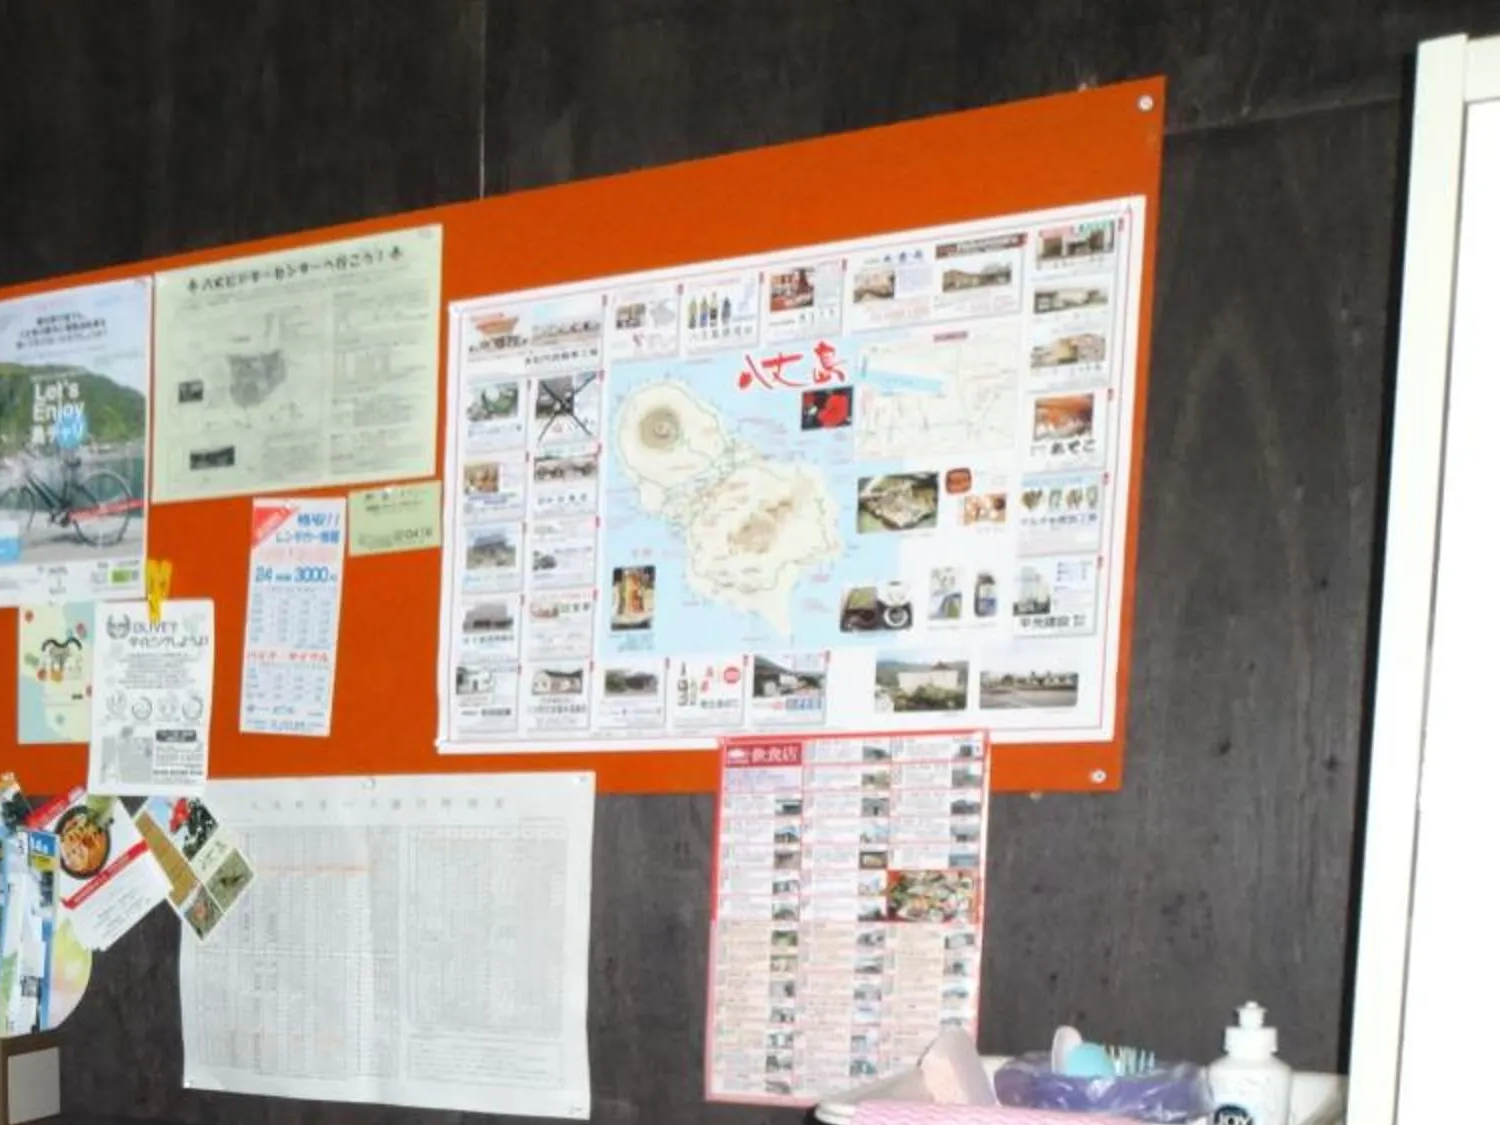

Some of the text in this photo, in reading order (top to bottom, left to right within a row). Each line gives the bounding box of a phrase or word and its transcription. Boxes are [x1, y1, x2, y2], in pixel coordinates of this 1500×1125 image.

[738, 340, 848, 391] 八丈島
[34, 380, 80, 400] Let's
[33, 401, 85, 424] Enjoy
